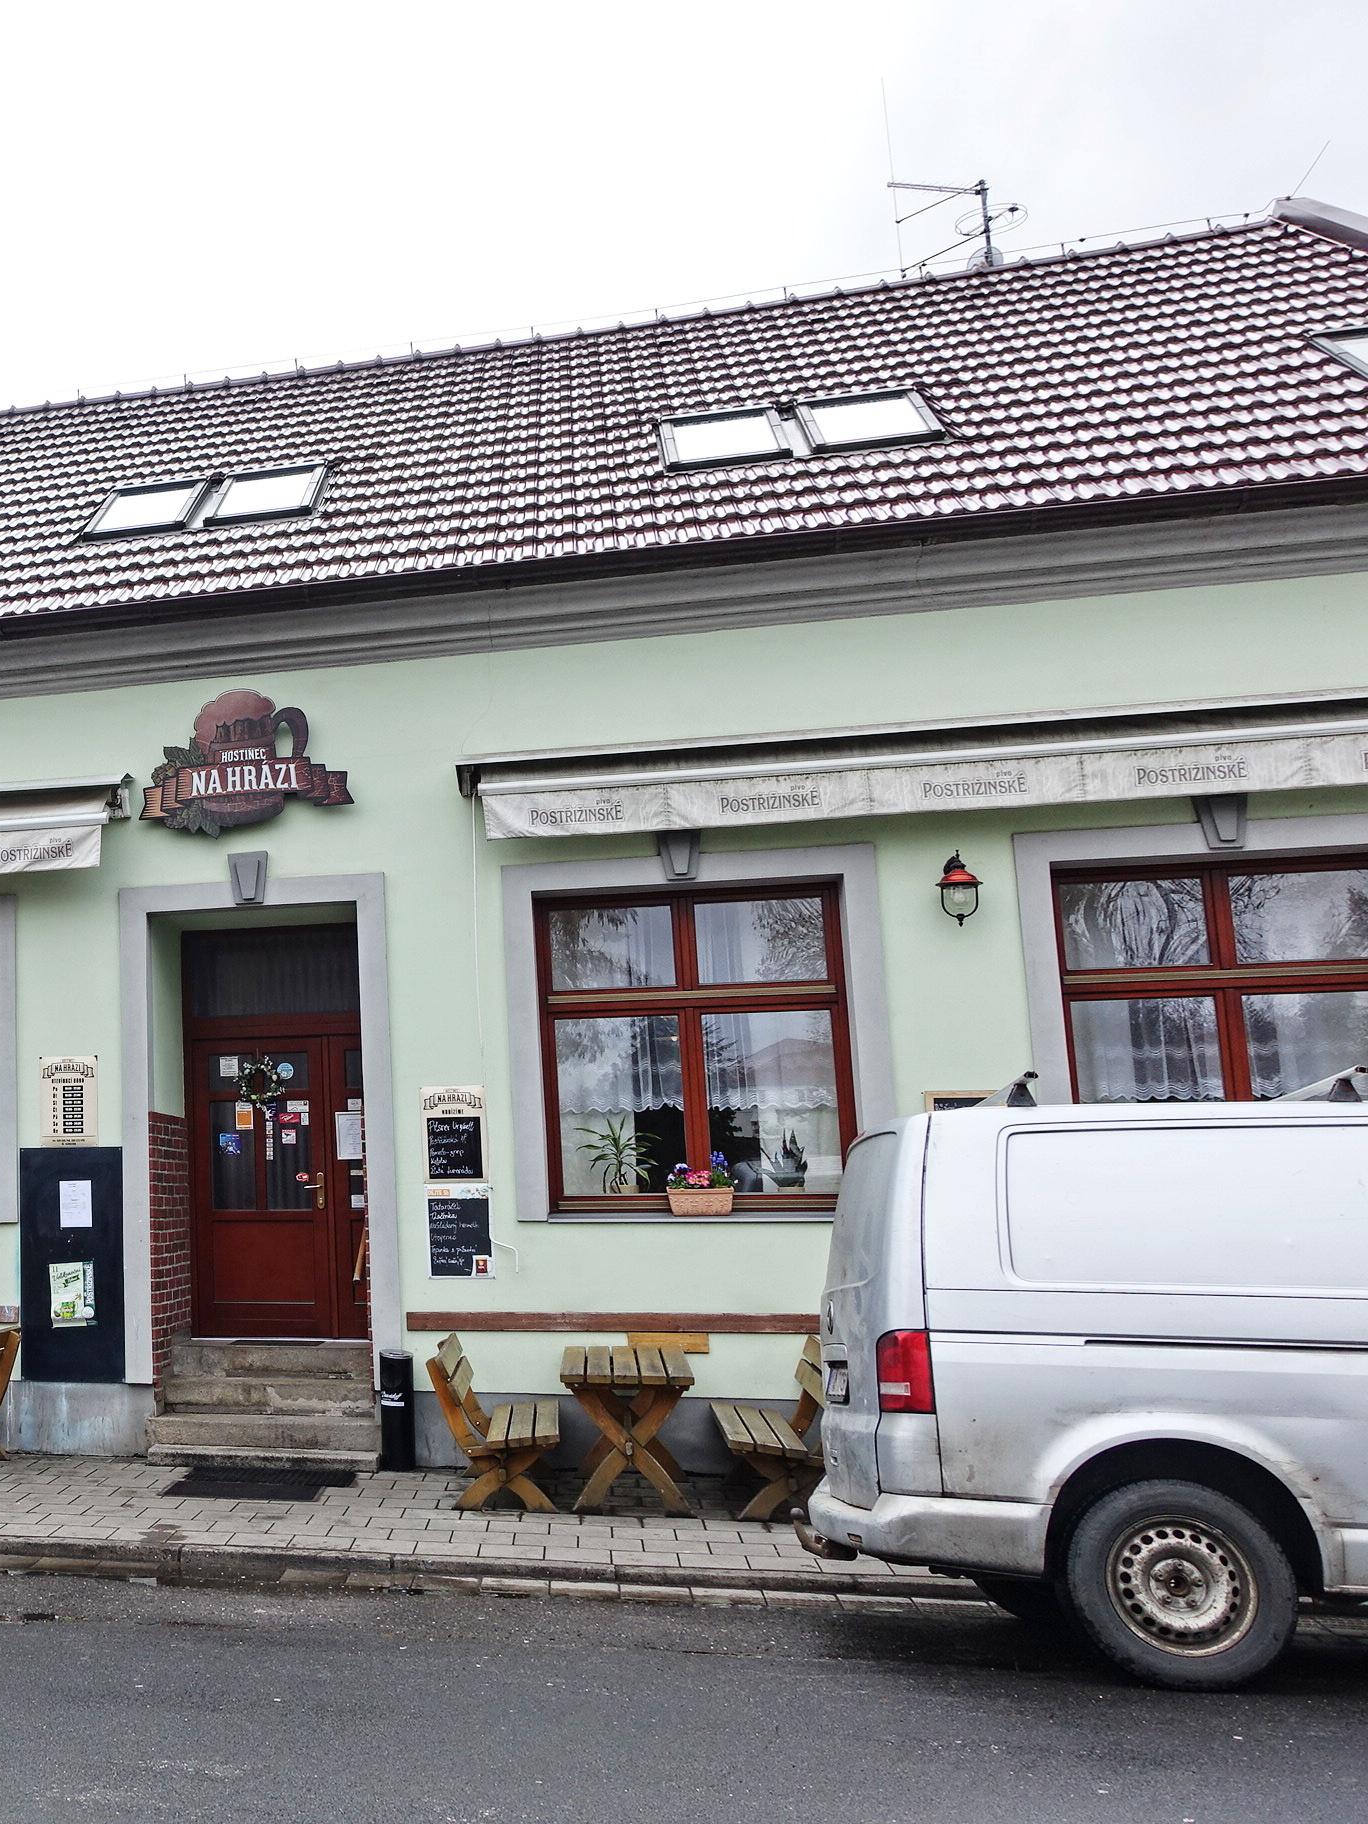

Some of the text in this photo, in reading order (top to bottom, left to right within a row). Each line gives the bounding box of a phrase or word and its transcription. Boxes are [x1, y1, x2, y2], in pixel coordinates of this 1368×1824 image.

[220, 748, 267, 763] HOSTINEC
[191, 761, 299, 797] NA HRÁZI
[1136, 758, 1247, 785] POSTŘIŽINSKÉ
[922, 772, 1028, 798] POSTŘIŽINSKÉ
[530, 800, 624, 825] POSTŘIŽINSKÉ
[719, 787, 820, 813] POSTŘIŽINSKÉ
